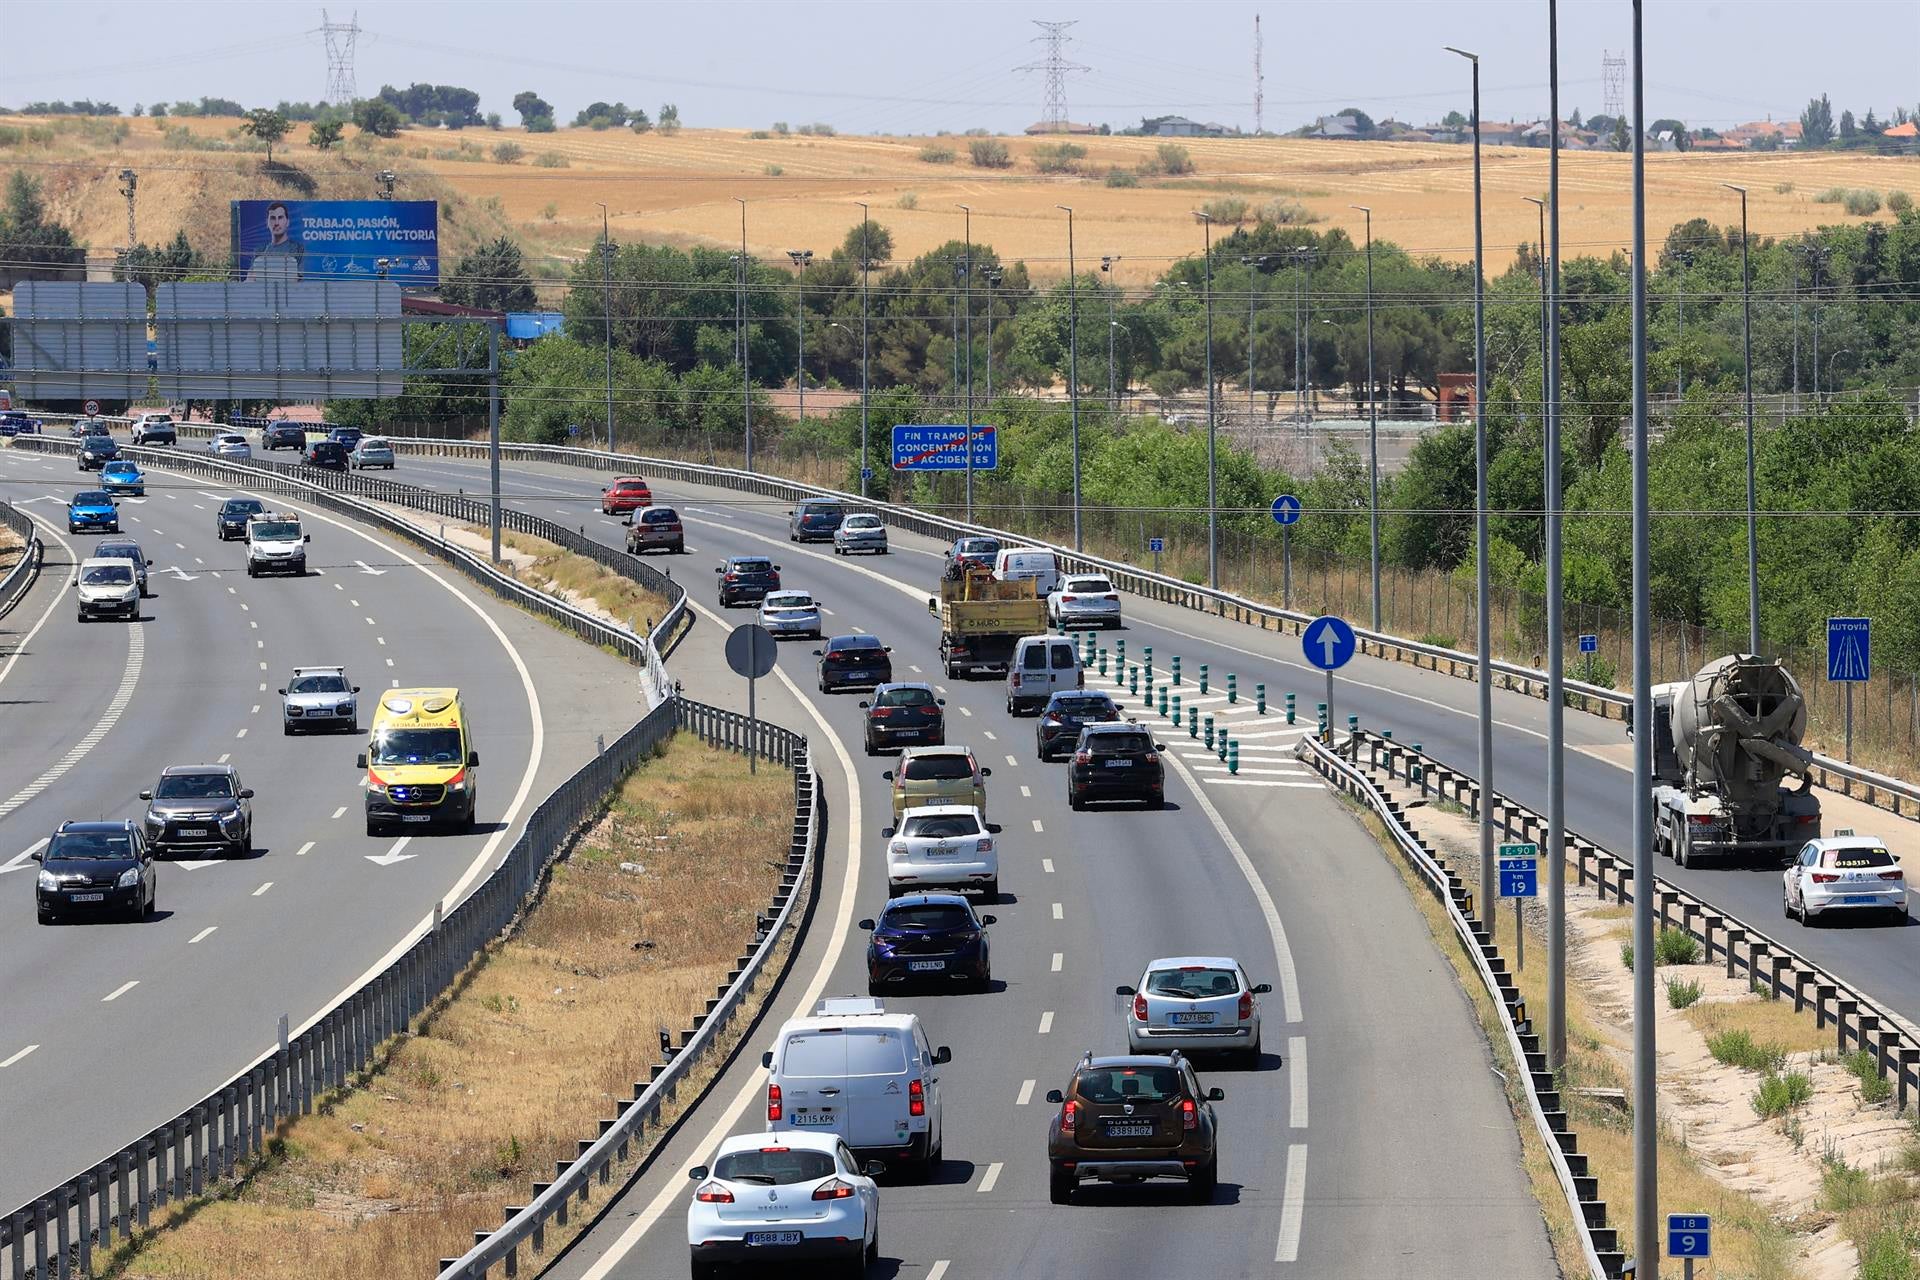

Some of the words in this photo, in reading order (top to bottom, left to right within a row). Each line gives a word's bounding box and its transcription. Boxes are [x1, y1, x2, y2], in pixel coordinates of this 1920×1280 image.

[302, 218, 356, 229] TRABAJO,
[357, 216, 400, 228] PASIÓN,
[302, 230, 374, 240] CONSTANCIA
[376, 230, 384, 240] Y
[385, 230, 436, 240] VICTORIA
[904, 432, 921, 440] FIN
[927, 432, 966, 440] TRAMO
[971, 432, 985, 440] DE
[900, 456, 914, 464] DE
[921, 455, 989, 464] ACCIDENES
[1830, 622, 1868, 631] AUTOVÍA
[1505, 847, 1530, 855] E-90
[1508, 860, 1529, 869] A-5
[1511, 882, 1526, 893] 19
[797, 1114, 818, 1123] 2115
[819, 1114, 835, 1123] KPK
[1110, 1126, 1133, 1135] 6389
[1134, 1126, 1151, 1135] HGZ
[1682, 1219, 1696, 1228] 18
[753, 1234, 778, 1243] 9588
[780, 1233, 799, 1242] JBX
[1681, 1235, 1696, 1252] 9
